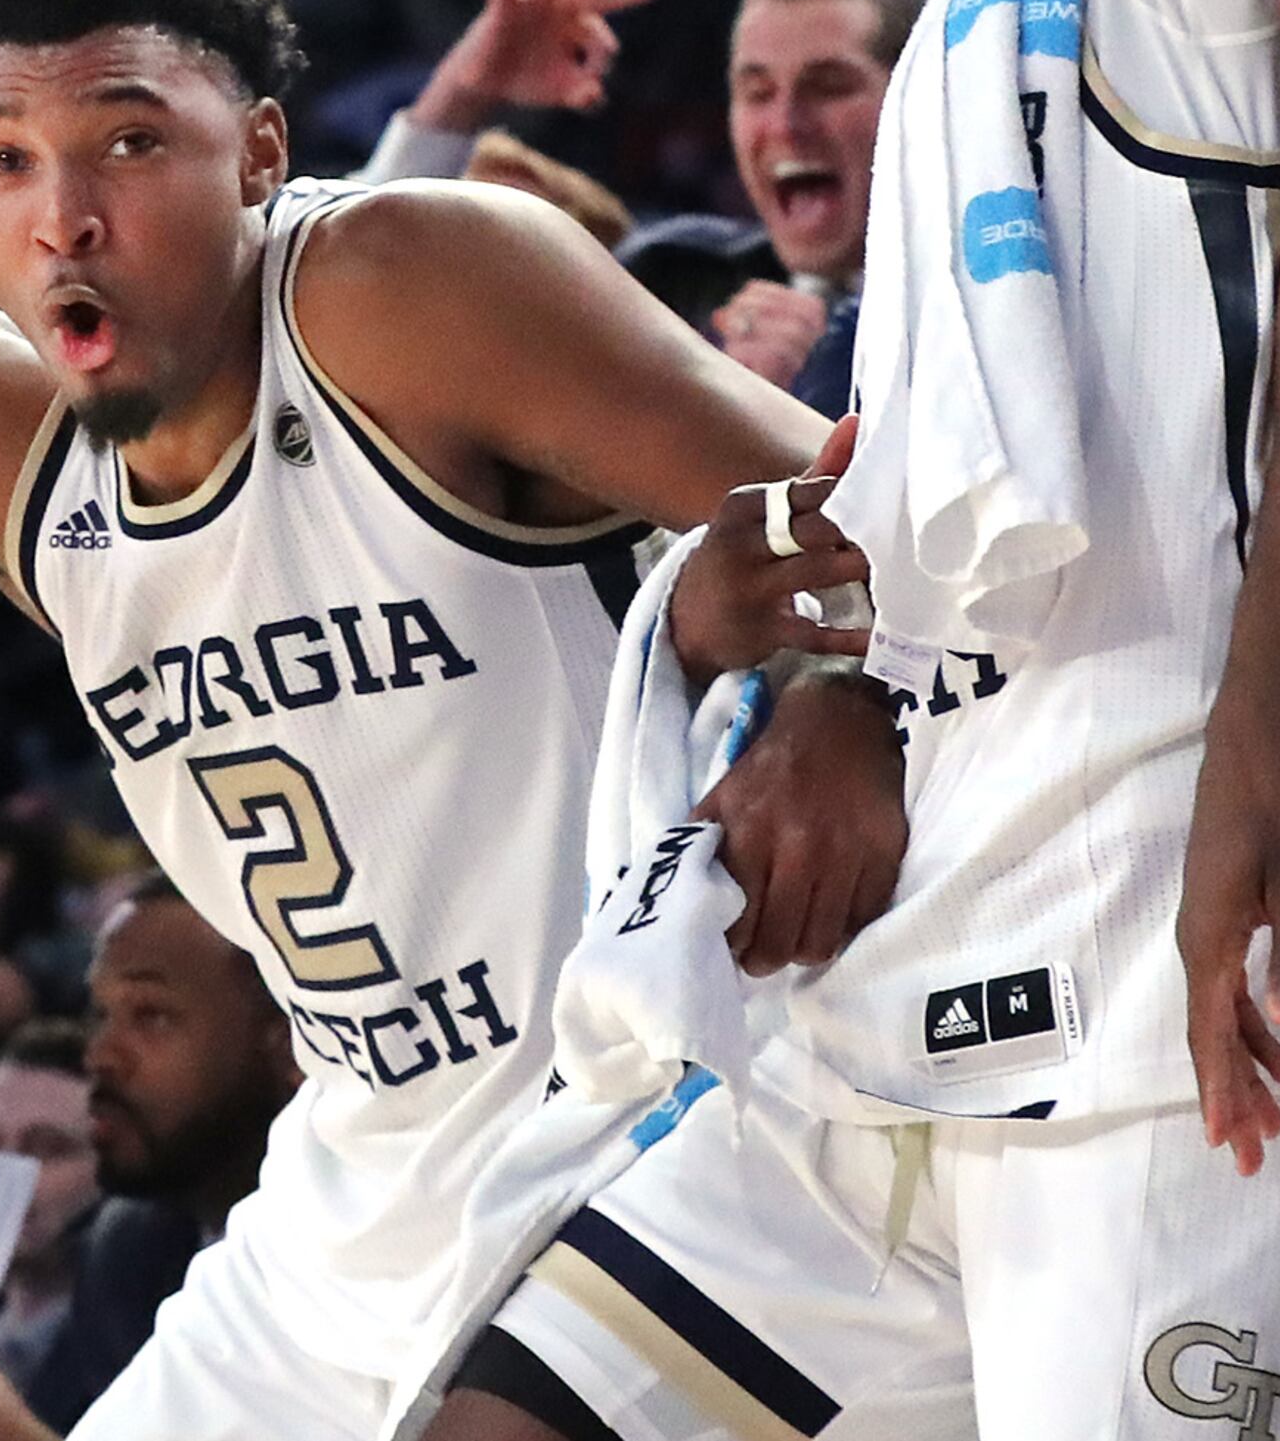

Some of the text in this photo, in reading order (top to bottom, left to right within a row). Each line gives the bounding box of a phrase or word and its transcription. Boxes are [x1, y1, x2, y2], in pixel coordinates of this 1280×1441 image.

[86, 598, 479, 762] EORGIA
[186, 744, 403, 992] 2
[287, 959, 519, 1093] TECH
[933, 1019, 981, 1040] adidas
[1009, 993, 1029, 1015] M
[1063, 995, 1078, 1040] LENGTH
